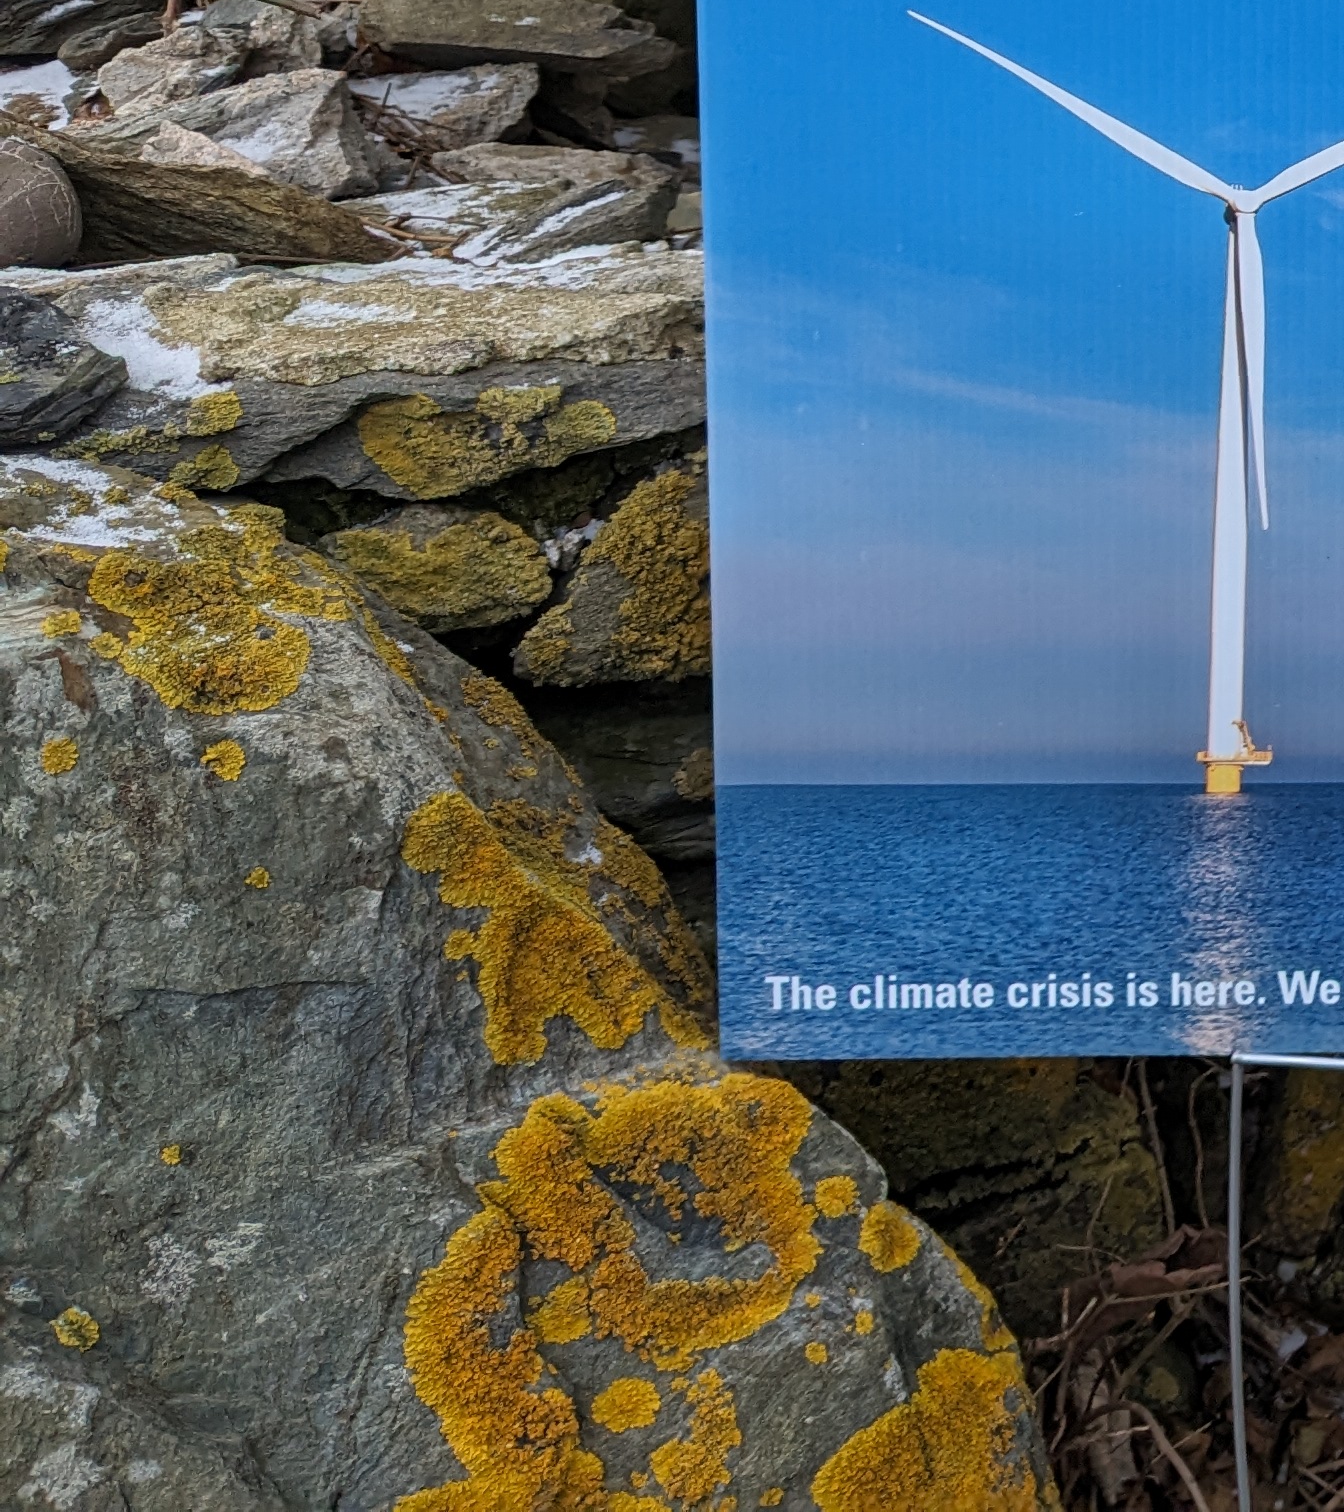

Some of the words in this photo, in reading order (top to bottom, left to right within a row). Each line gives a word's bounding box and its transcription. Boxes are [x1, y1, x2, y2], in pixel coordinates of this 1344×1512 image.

[764, 975, 837, 1010] The
[848, 975, 995, 1009] climate
[1006, 973, 1115, 1008] crisis
[1125, 972, 1160, 1007] is
[1170, 972, 1267, 1006] here.
[1276, 970, 1341, 1005] We
